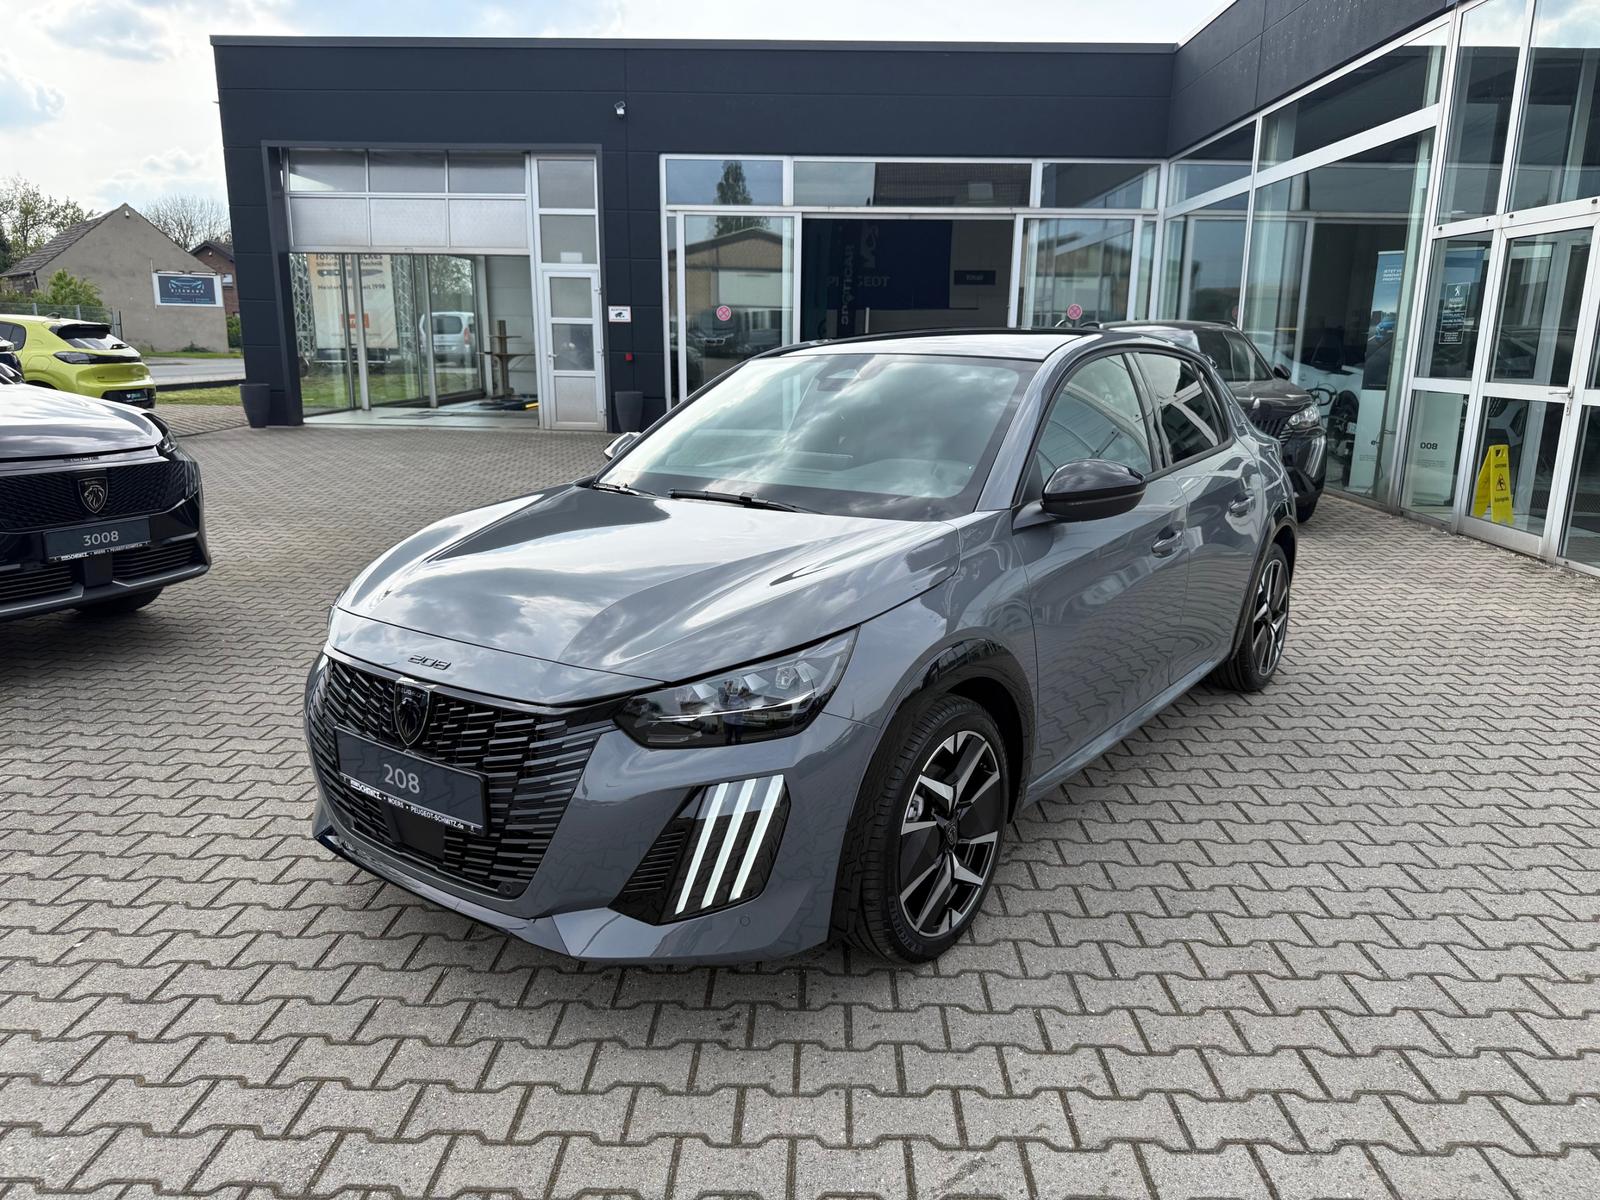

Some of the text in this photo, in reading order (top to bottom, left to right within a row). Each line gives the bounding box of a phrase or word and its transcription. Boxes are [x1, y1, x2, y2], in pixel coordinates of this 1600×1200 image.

[83, 530, 120, 547] 3008
[408, 654, 452, 671] 208
[383, 763, 420, 795] 208
[388, 797, 405, 809] MOERS
